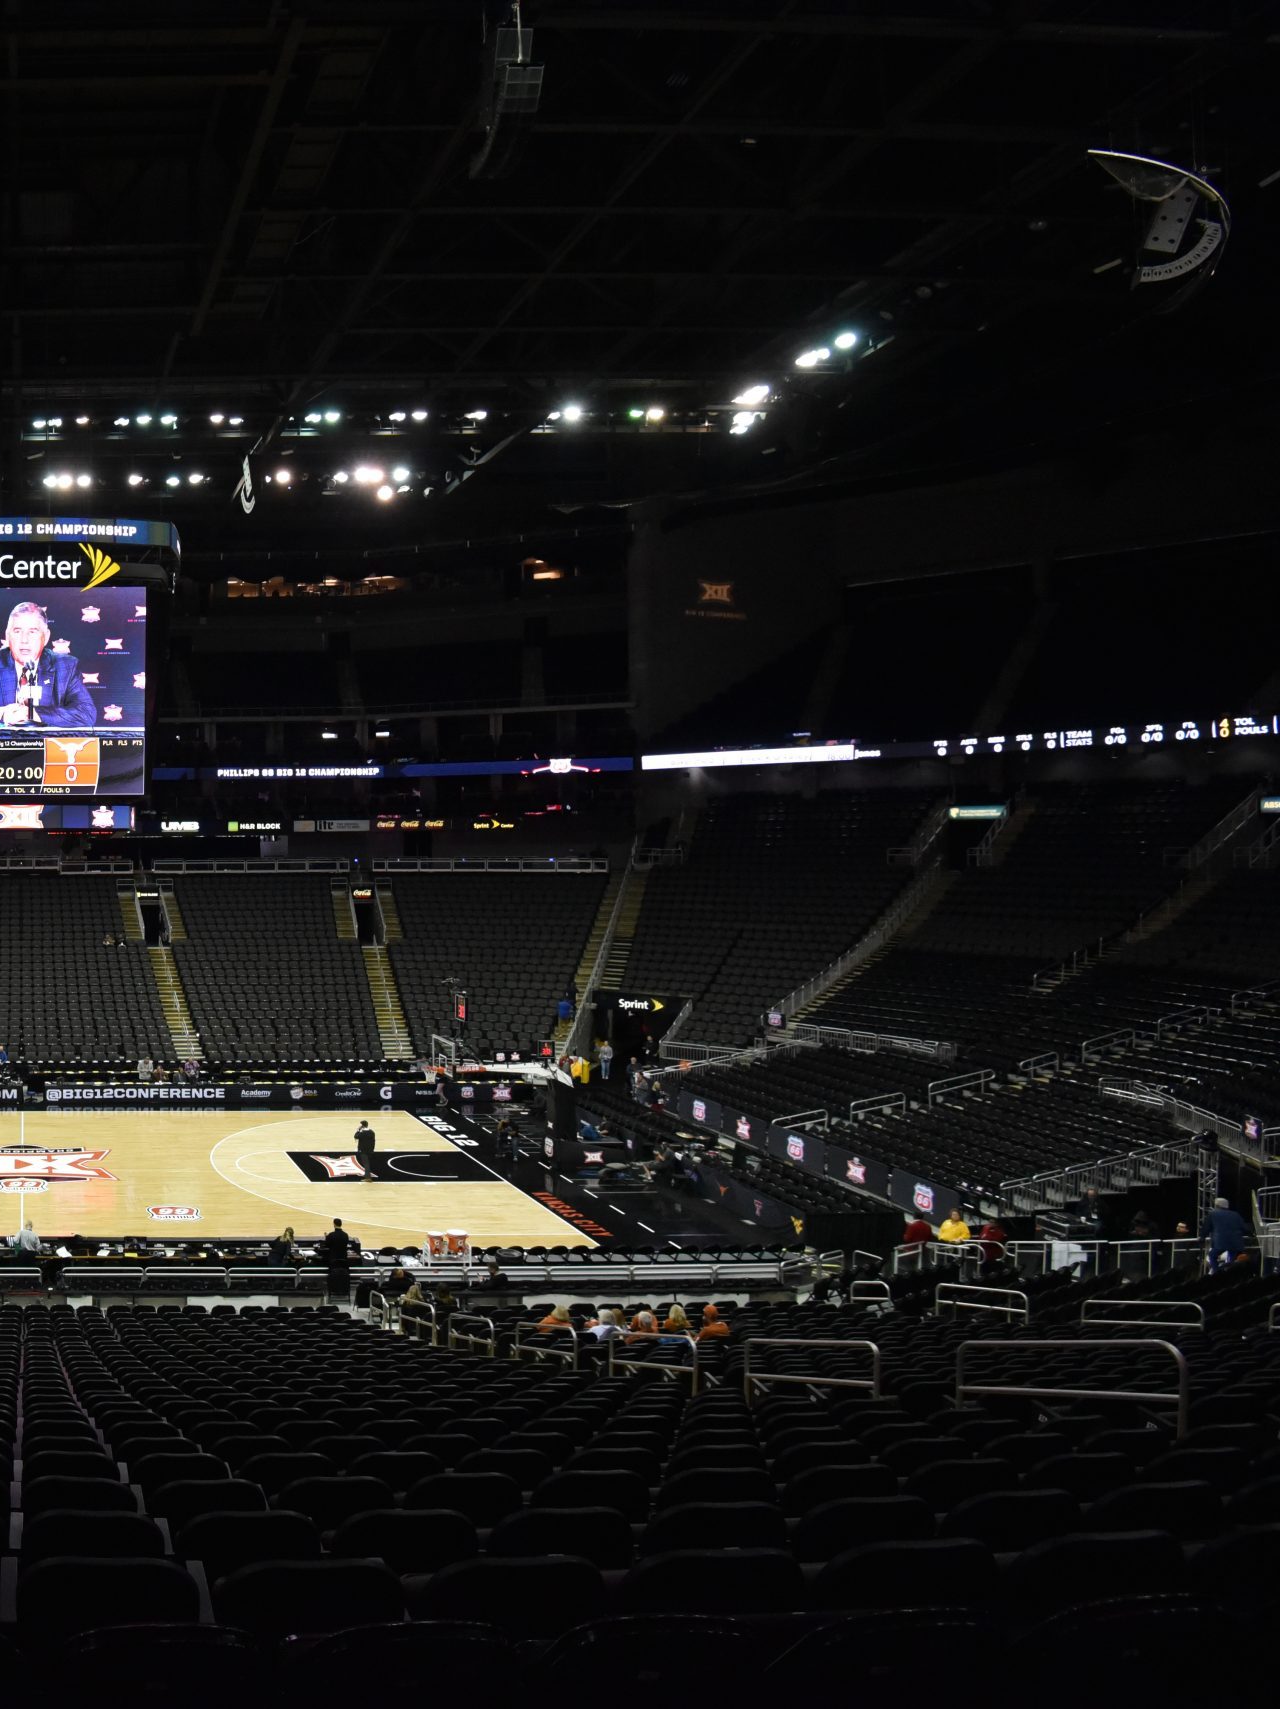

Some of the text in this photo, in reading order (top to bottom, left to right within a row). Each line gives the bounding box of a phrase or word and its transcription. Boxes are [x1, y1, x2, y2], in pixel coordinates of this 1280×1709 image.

[17, 524, 32, 534] 12
[37, 524, 137, 536] CHAMPIONSHIP
[1219, 717, 1255, 728] 4 TOL
[1065, 730, 1092, 739] TEAM
[1175, 729, 1199, 740] 0/0
[1220, 725, 1269, 738] 0 FOULS
[1065, 738, 1093, 747] STATS
[1104, 735, 1127, 745] 0/0
[1141, 732, 1164, 743] 0/0
[993, 743, 1003, 753] 0
[1021, 741, 1030, 751] 0
[1046, 739, 1056, 749] 0
[854, 749, 881, 760] Jones
[937, 747, 947, 756] 0
[965, 745, 974, 755] 0
[65, 765, 78, 782] 0
[217, 768, 260, 777] PHILLIPS
[276, 768, 293, 777] BIG
[295, 768, 307, 776] 12
[308, 767, 380, 776] CHAMPIONSHIP
[161, 821, 200, 831] UMB
[618, 998, 649, 1011] Sprint
[46, 1088, 226, 1101] @BIG12CONFERENCE
[240, 1089, 272, 1097] Academy
[379, 1086, 392, 1100] G
[419, 1115, 480, 1146] BIG 12
[531, 1191, 615, 1237] KANSAS CITY
